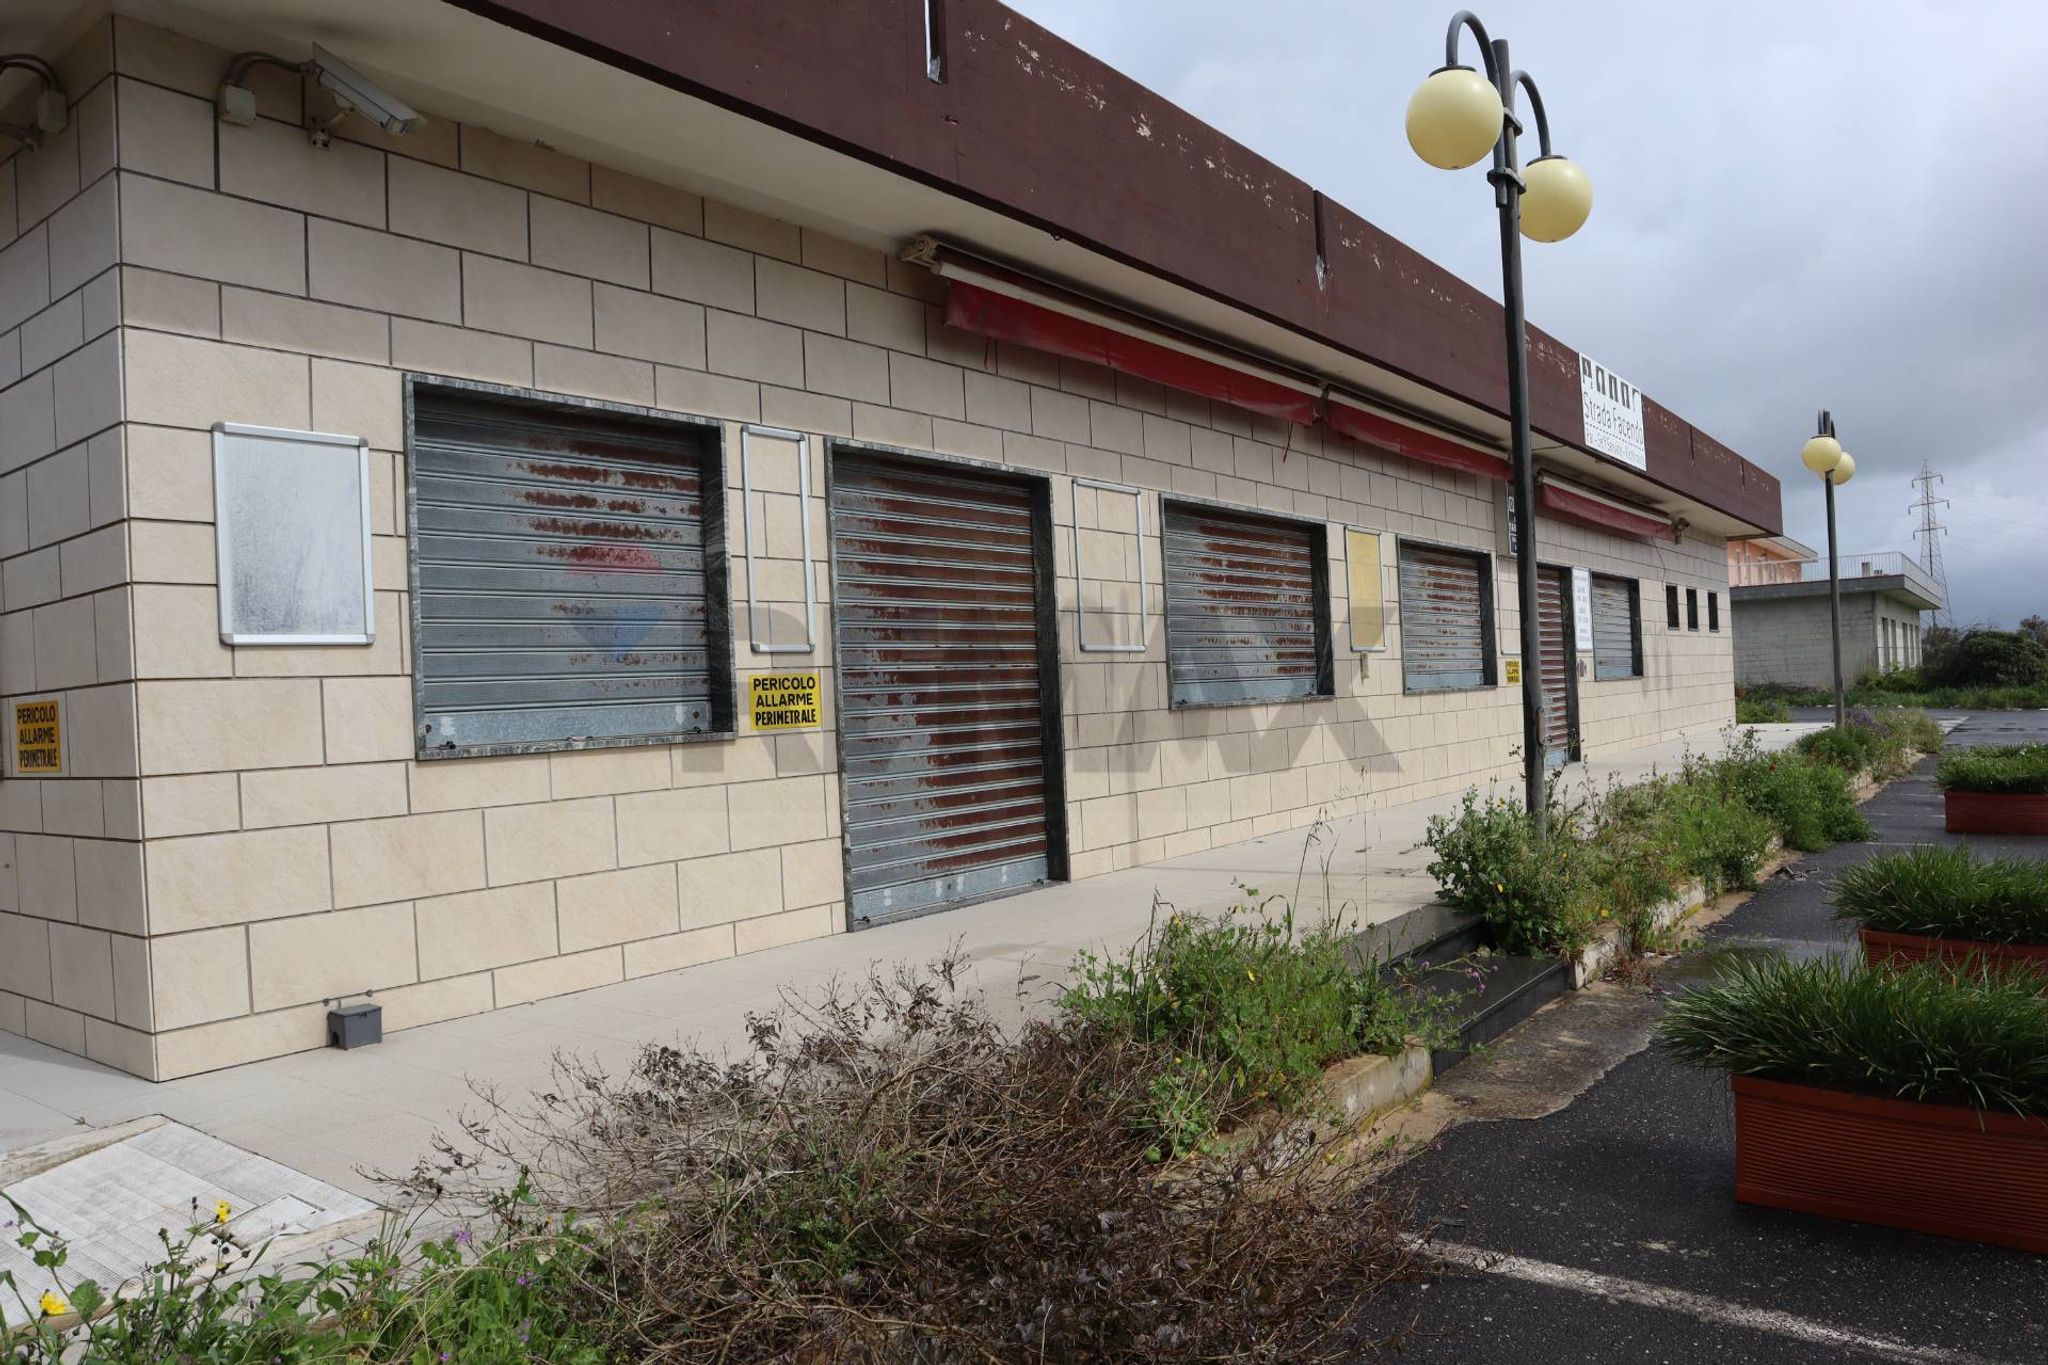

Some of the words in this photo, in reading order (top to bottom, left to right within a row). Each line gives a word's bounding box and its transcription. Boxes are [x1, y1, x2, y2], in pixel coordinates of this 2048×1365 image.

[1583, 391, 1612, 429] Strada
[1612, 407, 1644, 445] Facendo
[753, 676, 816, 691] PERICOLO
[756, 693, 814, 708] ALLARME
[17, 705, 56, 724] PERICOLO
[755, 709, 817, 726] PERIMETRALE
[20, 727, 55, 745] ALLARME
[19, 748, 57, 768] PERIMETRALE
